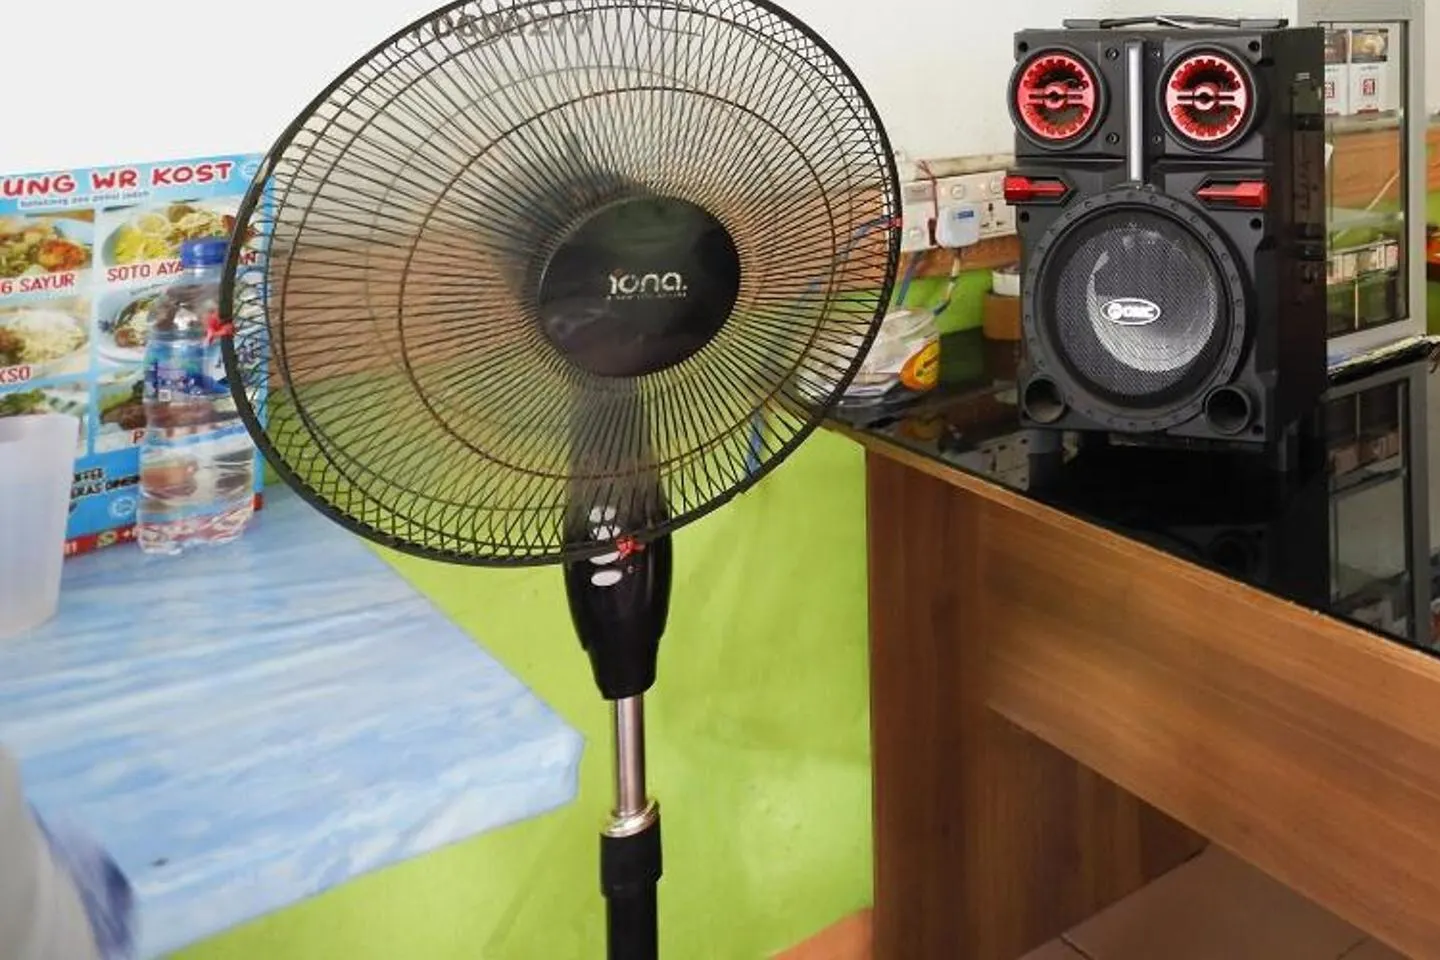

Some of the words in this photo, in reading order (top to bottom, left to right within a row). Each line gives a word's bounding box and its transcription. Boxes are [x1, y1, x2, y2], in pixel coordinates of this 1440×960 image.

[92, 170, 137, 190] WR
[152, 163, 232, 186] KOST
[107, 264, 151, 282] SOTO
[156, 260, 185, 276] AYA
[19, 273, 75, 293] SAYUR
